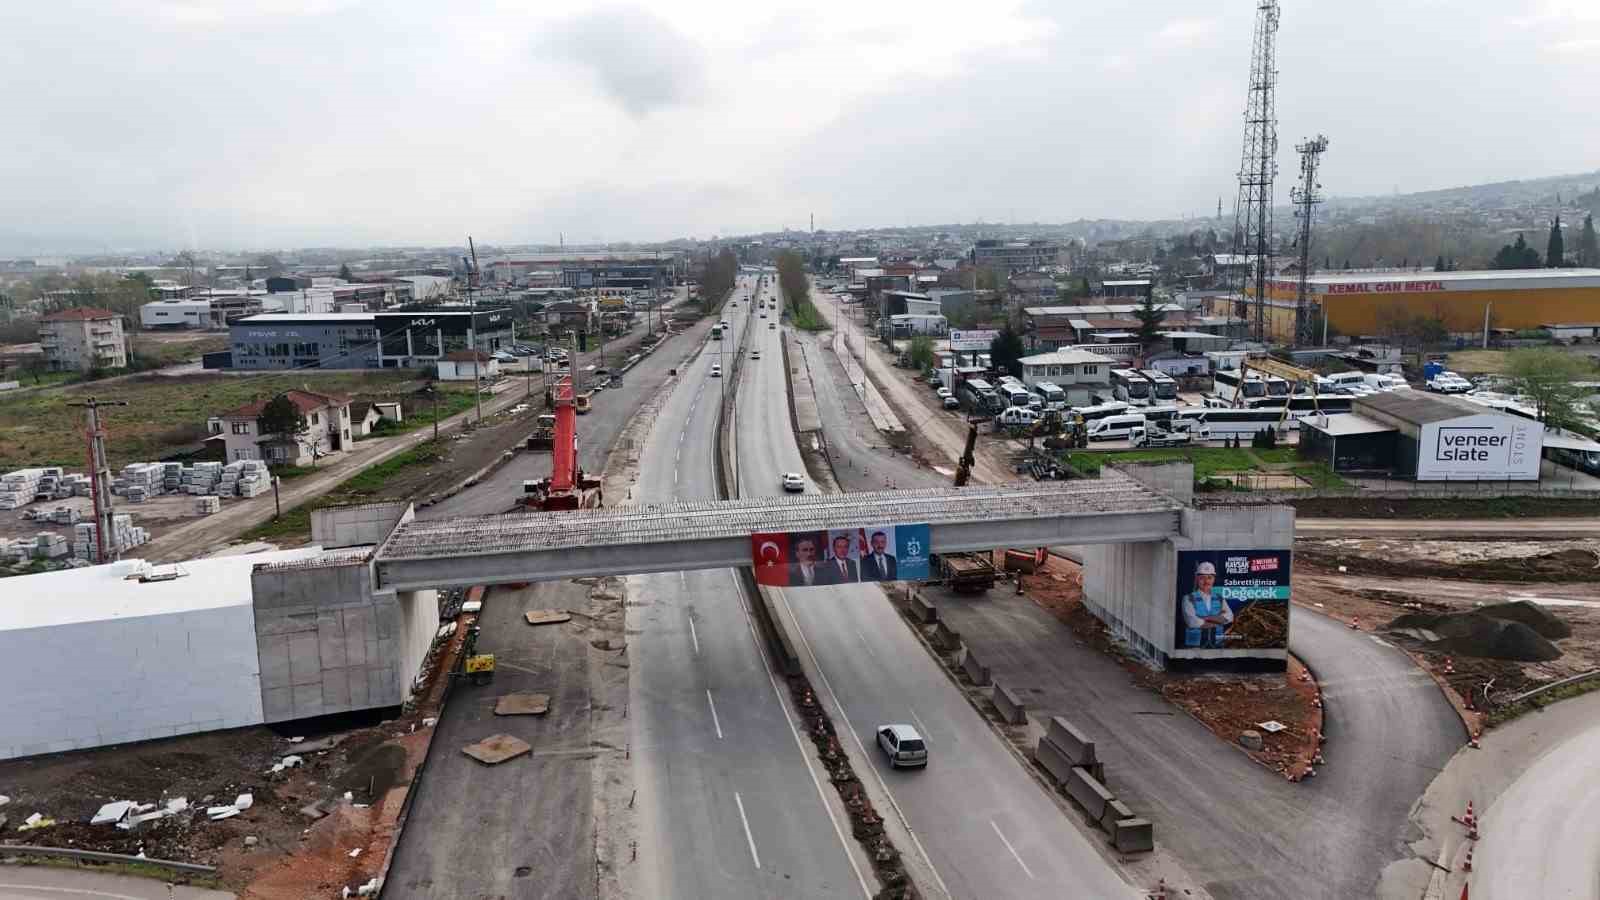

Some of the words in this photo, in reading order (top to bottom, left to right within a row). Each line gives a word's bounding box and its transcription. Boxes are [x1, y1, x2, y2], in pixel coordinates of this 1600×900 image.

[1328, 283, 1371, 294] KEMAL
[1376, 283, 1401, 292] CAN
[1405, 281, 1446, 291] METAL
[411, 318, 435, 326] KIA
[1444, 435, 1507, 447] veneer
[1443, 448, 1488, 461] slate
[1224, 578, 1277, 588] Sabrettiğinize
[1222, 586, 1277, 601] Değecek
